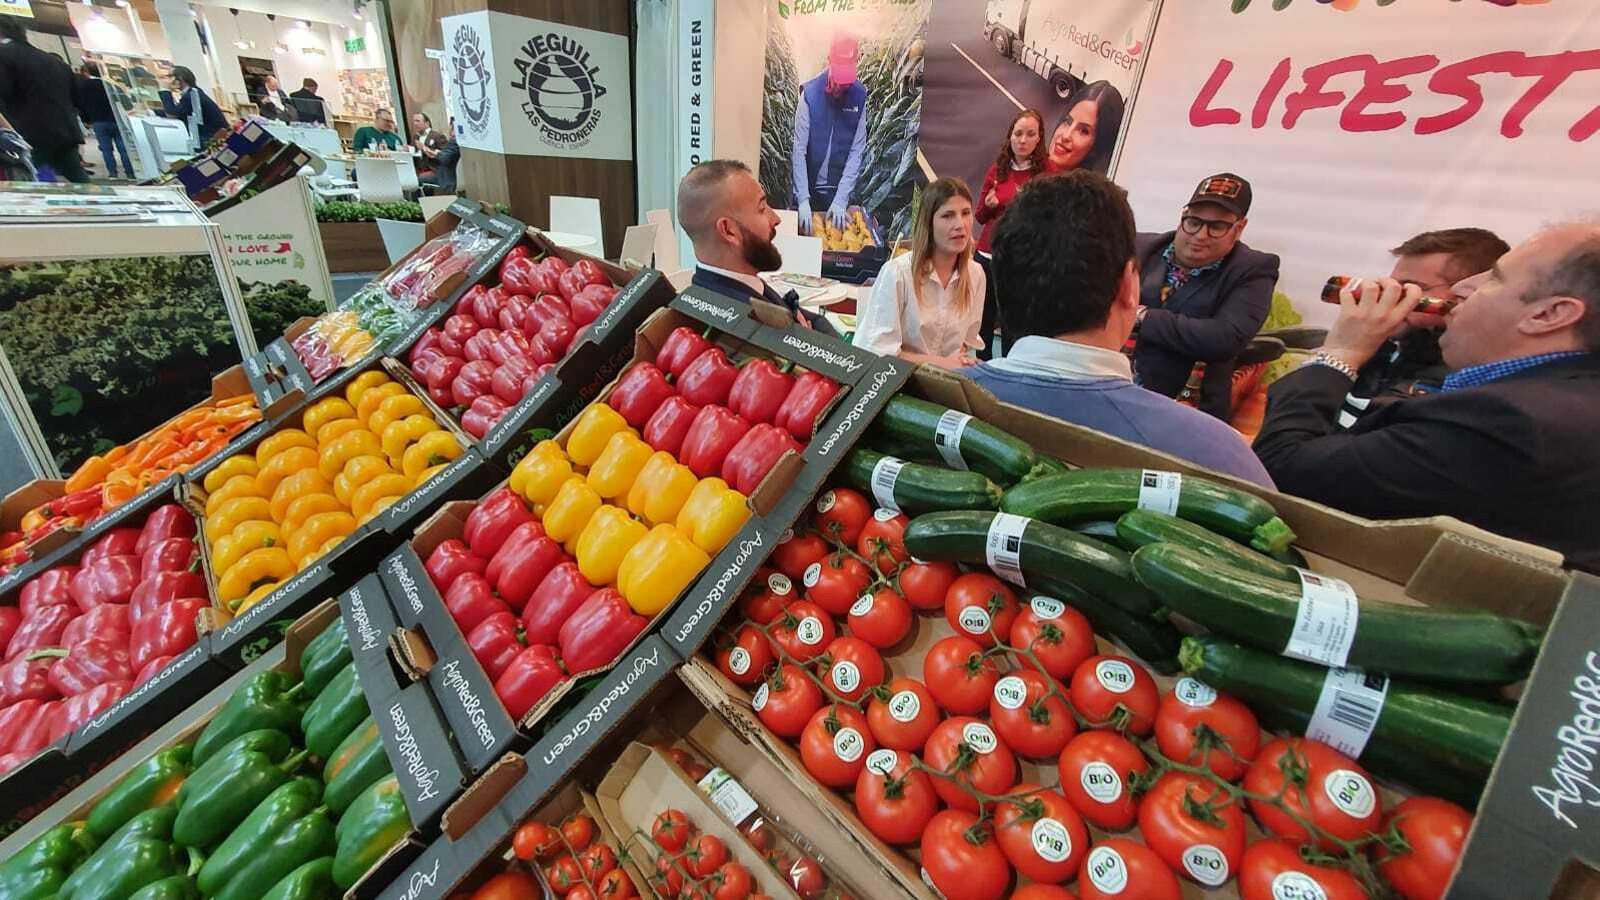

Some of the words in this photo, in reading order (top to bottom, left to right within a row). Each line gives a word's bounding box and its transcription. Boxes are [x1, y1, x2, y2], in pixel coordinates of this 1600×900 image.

[511, 58, 532, 90] LA
[521, 33, 607, 100] VEGUILLA
[690, 20, 702, 87] GREEN
[521, 102, 542, 127] LAS
[540, 109, 602, 143] PEDRONERAS
[690, 92, 701, 106] &
[690, 113, 701, 148] RED
[238, 245, 270, 254] LOVE
[255, 257, 288, 266] HOME
[595, 273, 652, 335] AgroRed&Green
[680, 293, 740, 324] AgroRed&Green
[783, 334, 864, 373] AgroRed&Green
[485, 381, 551, 451] AgroRed&Green
[818, 364, 897, 456] AgroRed&Green
[391, 453, 475, 519] AgroRed&Green
[221, 565, 323, 641] AgroRed&Green
[387, 554, 425, 616] AgroRed&Green
[676, 530, 763, 643] AgroRed&Green
[350, 585, 381, 652] AgroRed&Green
[81, 648, 202, 736] AgroRed&Green
[443, 660, 497, 751] AgroRed&Green
[543, 647, 660, 766] AgroRed&Green
[389, 703, 440, 802] AgroRed&Green
